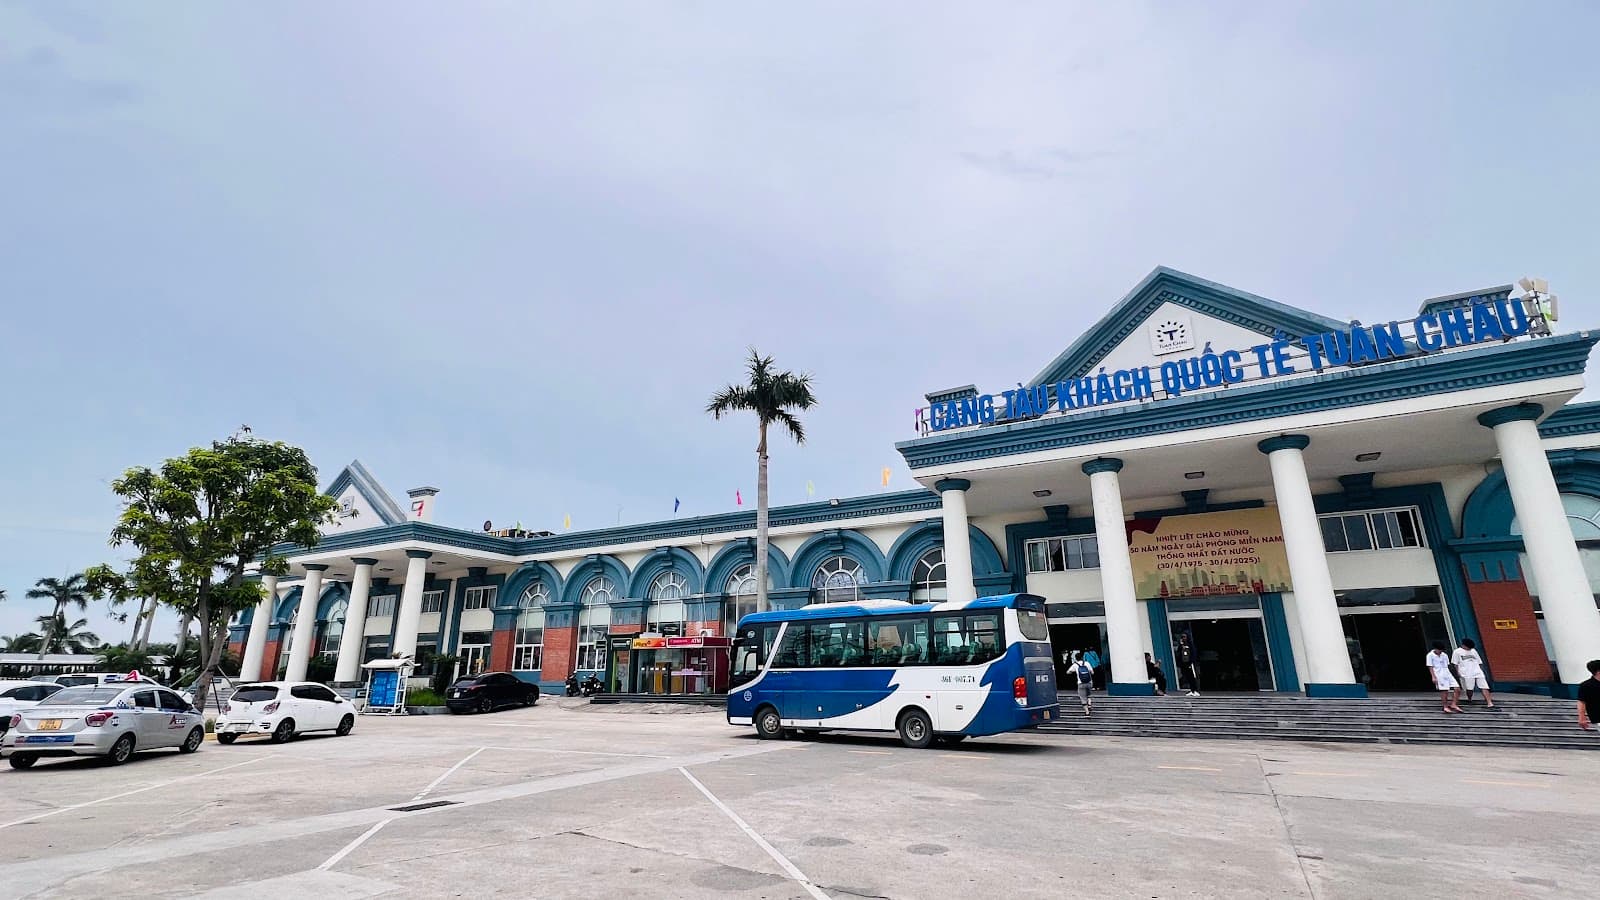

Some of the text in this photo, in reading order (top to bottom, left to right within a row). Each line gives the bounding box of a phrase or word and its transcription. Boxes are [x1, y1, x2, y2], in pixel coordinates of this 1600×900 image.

[1002, 382, 1049, 419] TÀU
[1056, 366, 1151, 410] KHÁCH
[1161, 341, 1244, 396] QUỐC
[1251, 328, 1295, 378] TẾ
[1414, 296, 1529, 352] CHÂU
[1157, 560, 1203, 570] (30/4/1975
